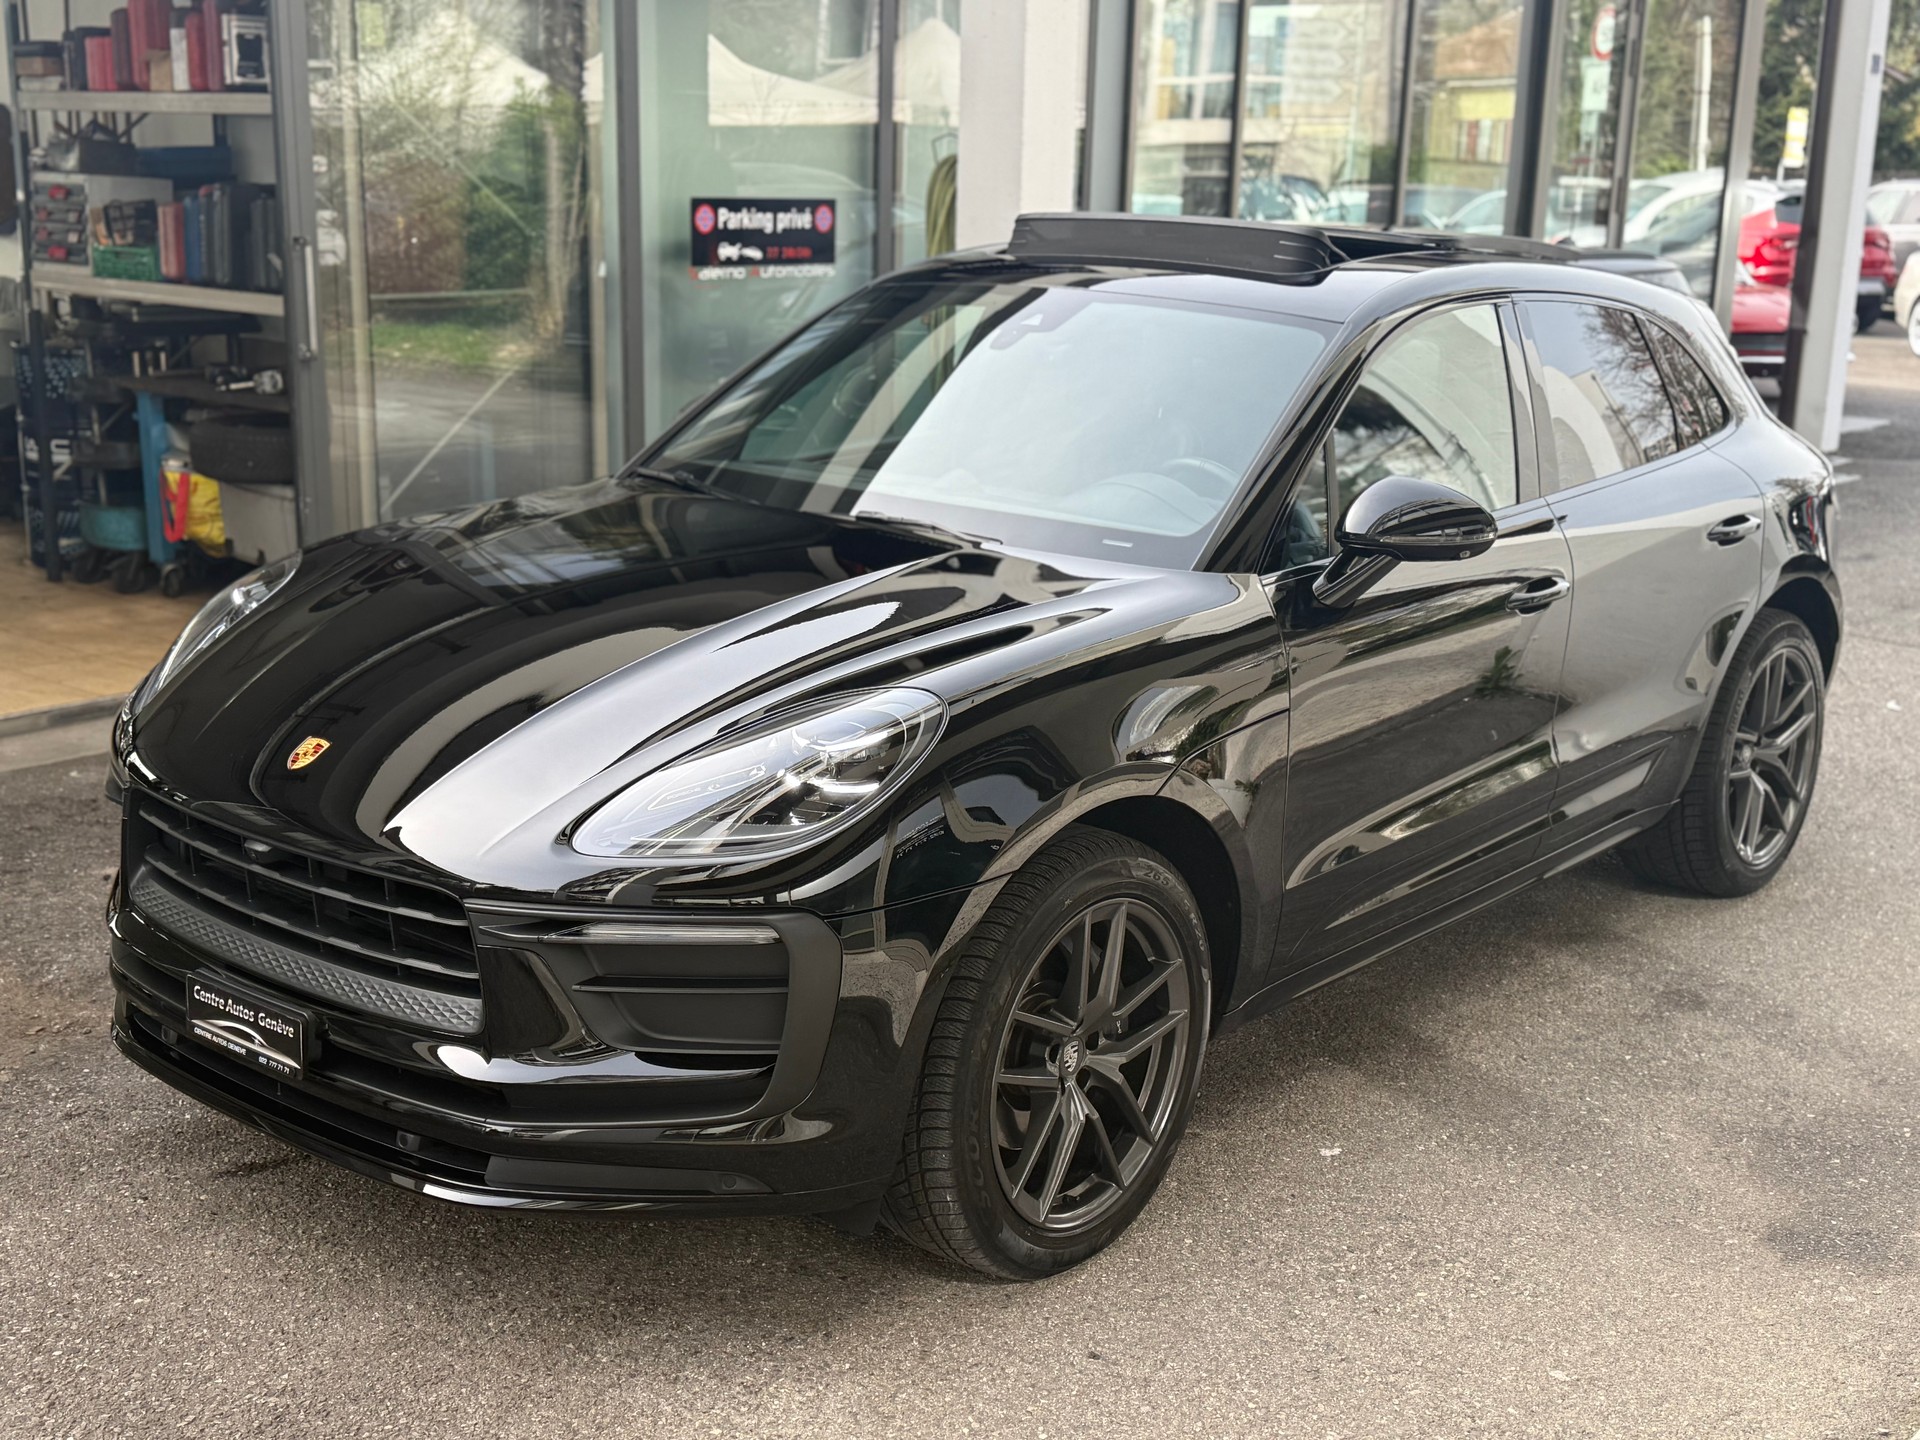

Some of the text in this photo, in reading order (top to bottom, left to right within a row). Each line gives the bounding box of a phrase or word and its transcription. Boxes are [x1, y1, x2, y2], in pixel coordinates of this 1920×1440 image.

[716, 206, 812, 234] Parking privé
[1143, 866, 1171, 889] 265
[193, 985, 294, 1038] Centre Autos Genève
[193, 1027, 212, 1040] CENTRE
[212, 1035, 227, 1047] AUTOS
[278, 1064, 284, 1072] 71
[284, 1066, 290, 1075] 71
